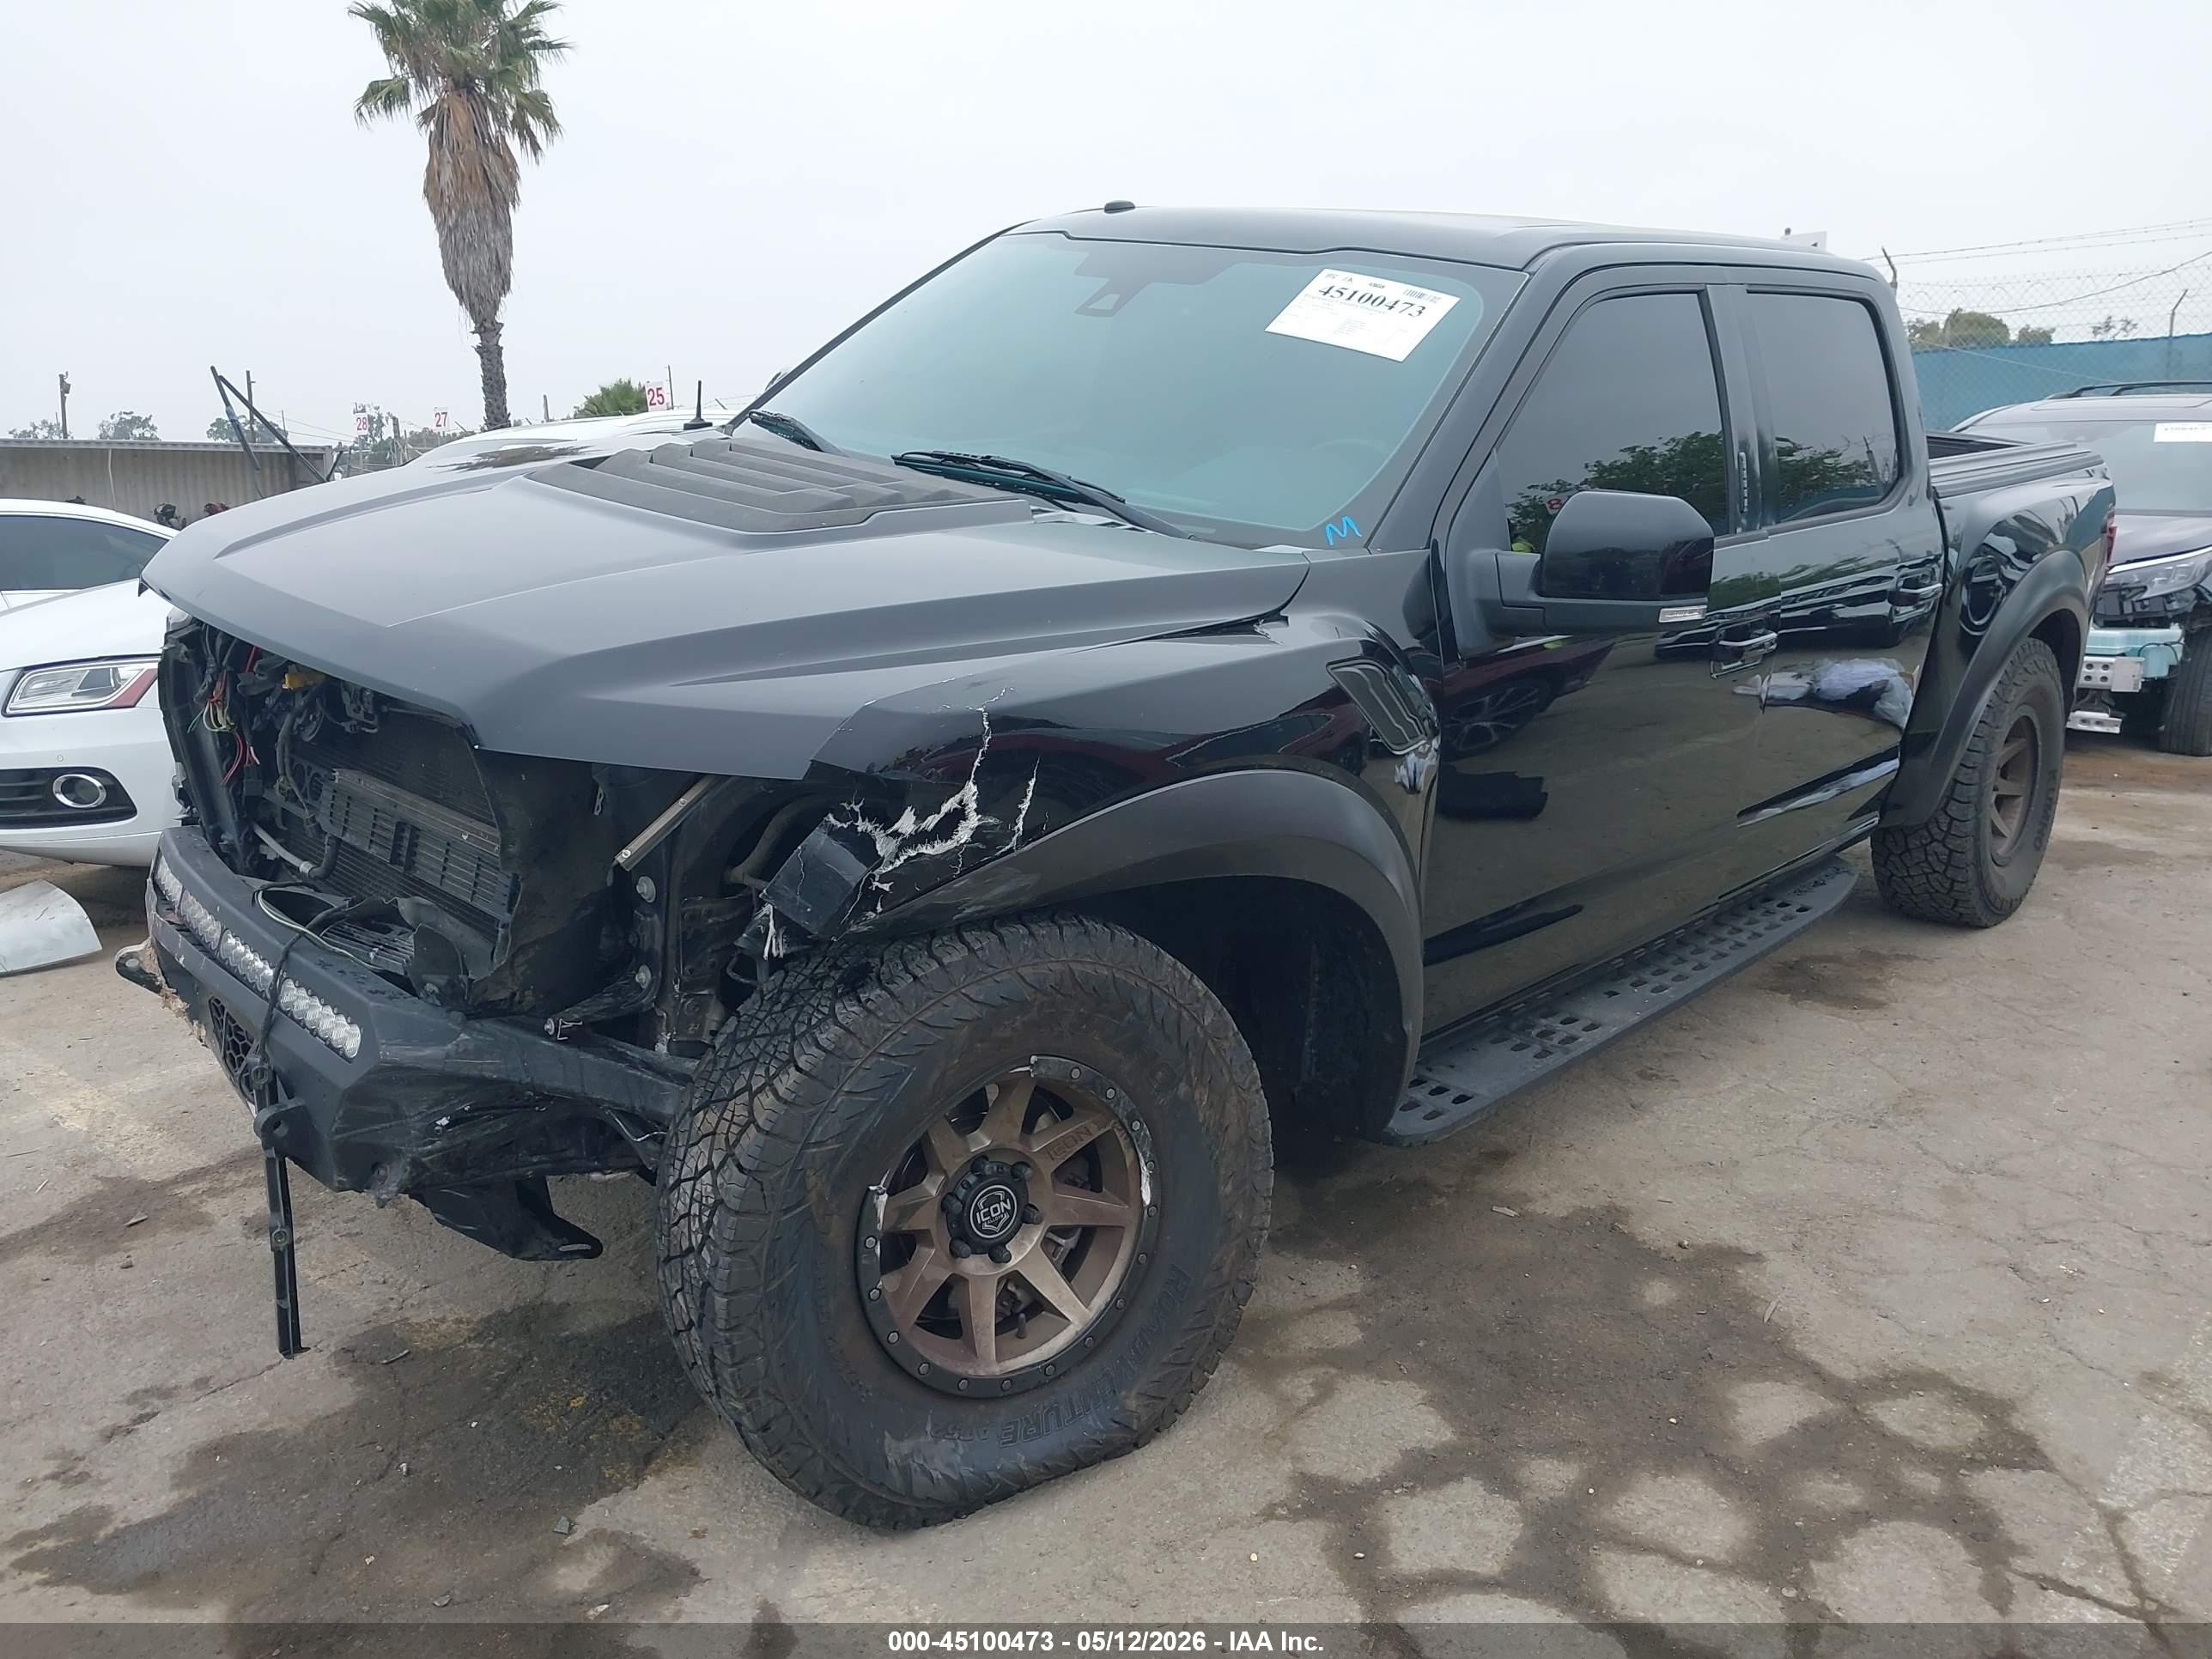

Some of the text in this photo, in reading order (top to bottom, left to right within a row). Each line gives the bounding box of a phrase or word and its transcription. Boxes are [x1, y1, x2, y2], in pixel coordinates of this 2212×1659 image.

[1318, 284, 1427, 318] 45100473
[647, 386, 665, 406] 25
[356, 416, 368, 431] 28
[434, 411, 448, 427] 27
[1046, 1126, 1093, 1161] ICON
[975, 1198, 1012, 1224] ICON
